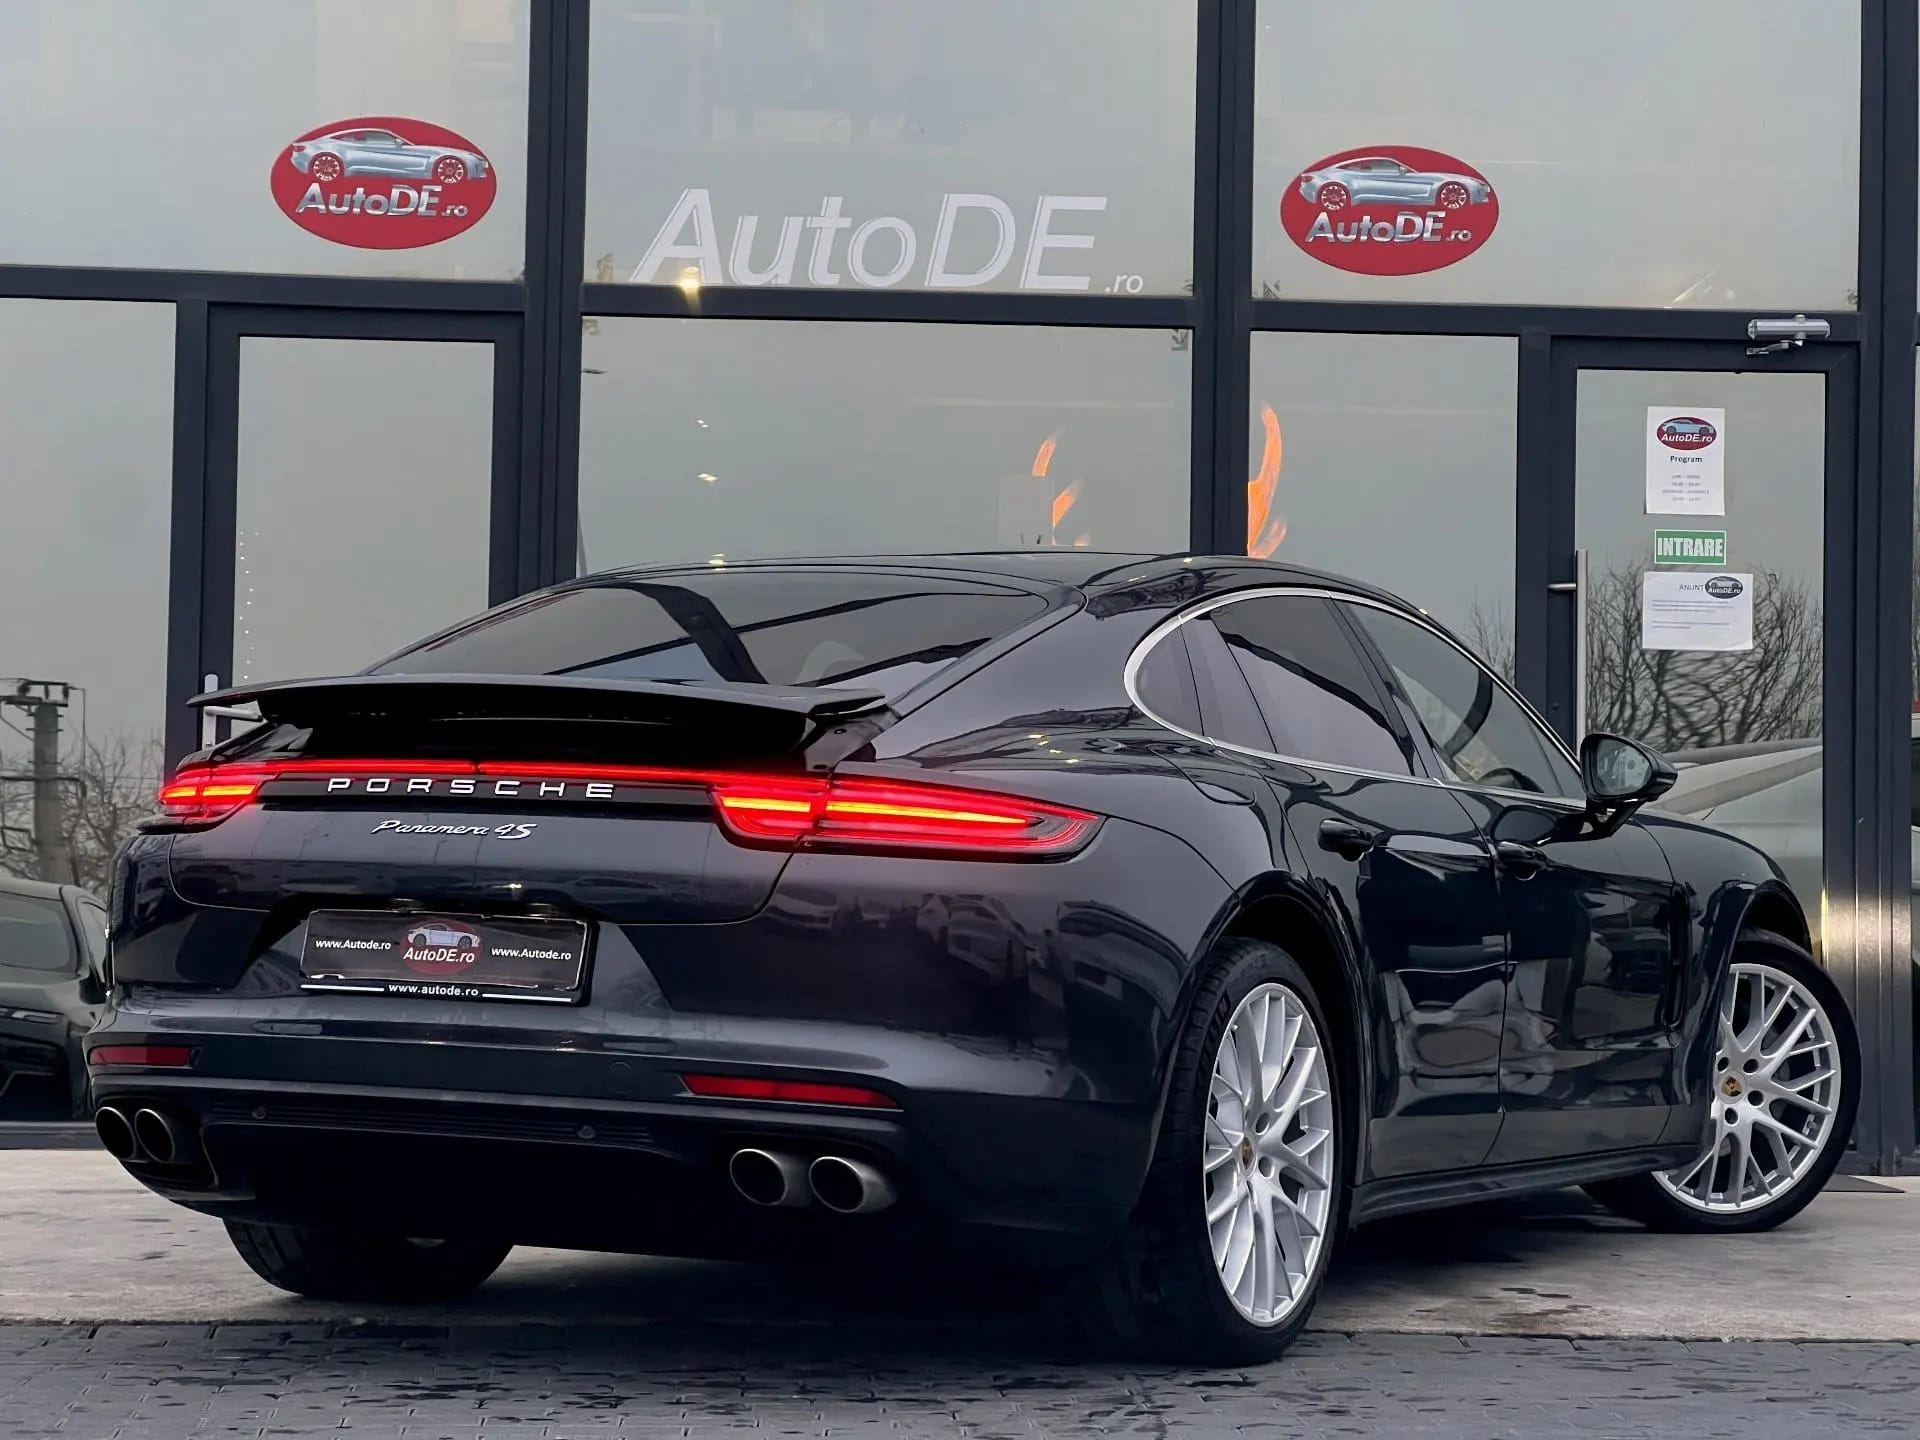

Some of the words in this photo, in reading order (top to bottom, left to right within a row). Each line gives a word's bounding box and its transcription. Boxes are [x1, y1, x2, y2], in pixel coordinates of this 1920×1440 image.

[1661, 433, 1713, 443] AutoDE.ro
[1670, 455, 1703, 463] Program
[1657, 537, 1723, 557] INTRARE
[1679, 584, 1705, 592] ANUNT
[327, 778, 614, 799] PORSCHE
[370, 820, 490, 835] Panamera
[494, 823, 538, 839] 4S
[315, 938, 391, 950] www.Autode.ro
[403, 946, 475, 963] AutoDE.ro
[491, 947, 572, 960] www.Autode.ro
[388, 983, 479, 997] www.autode.ro
